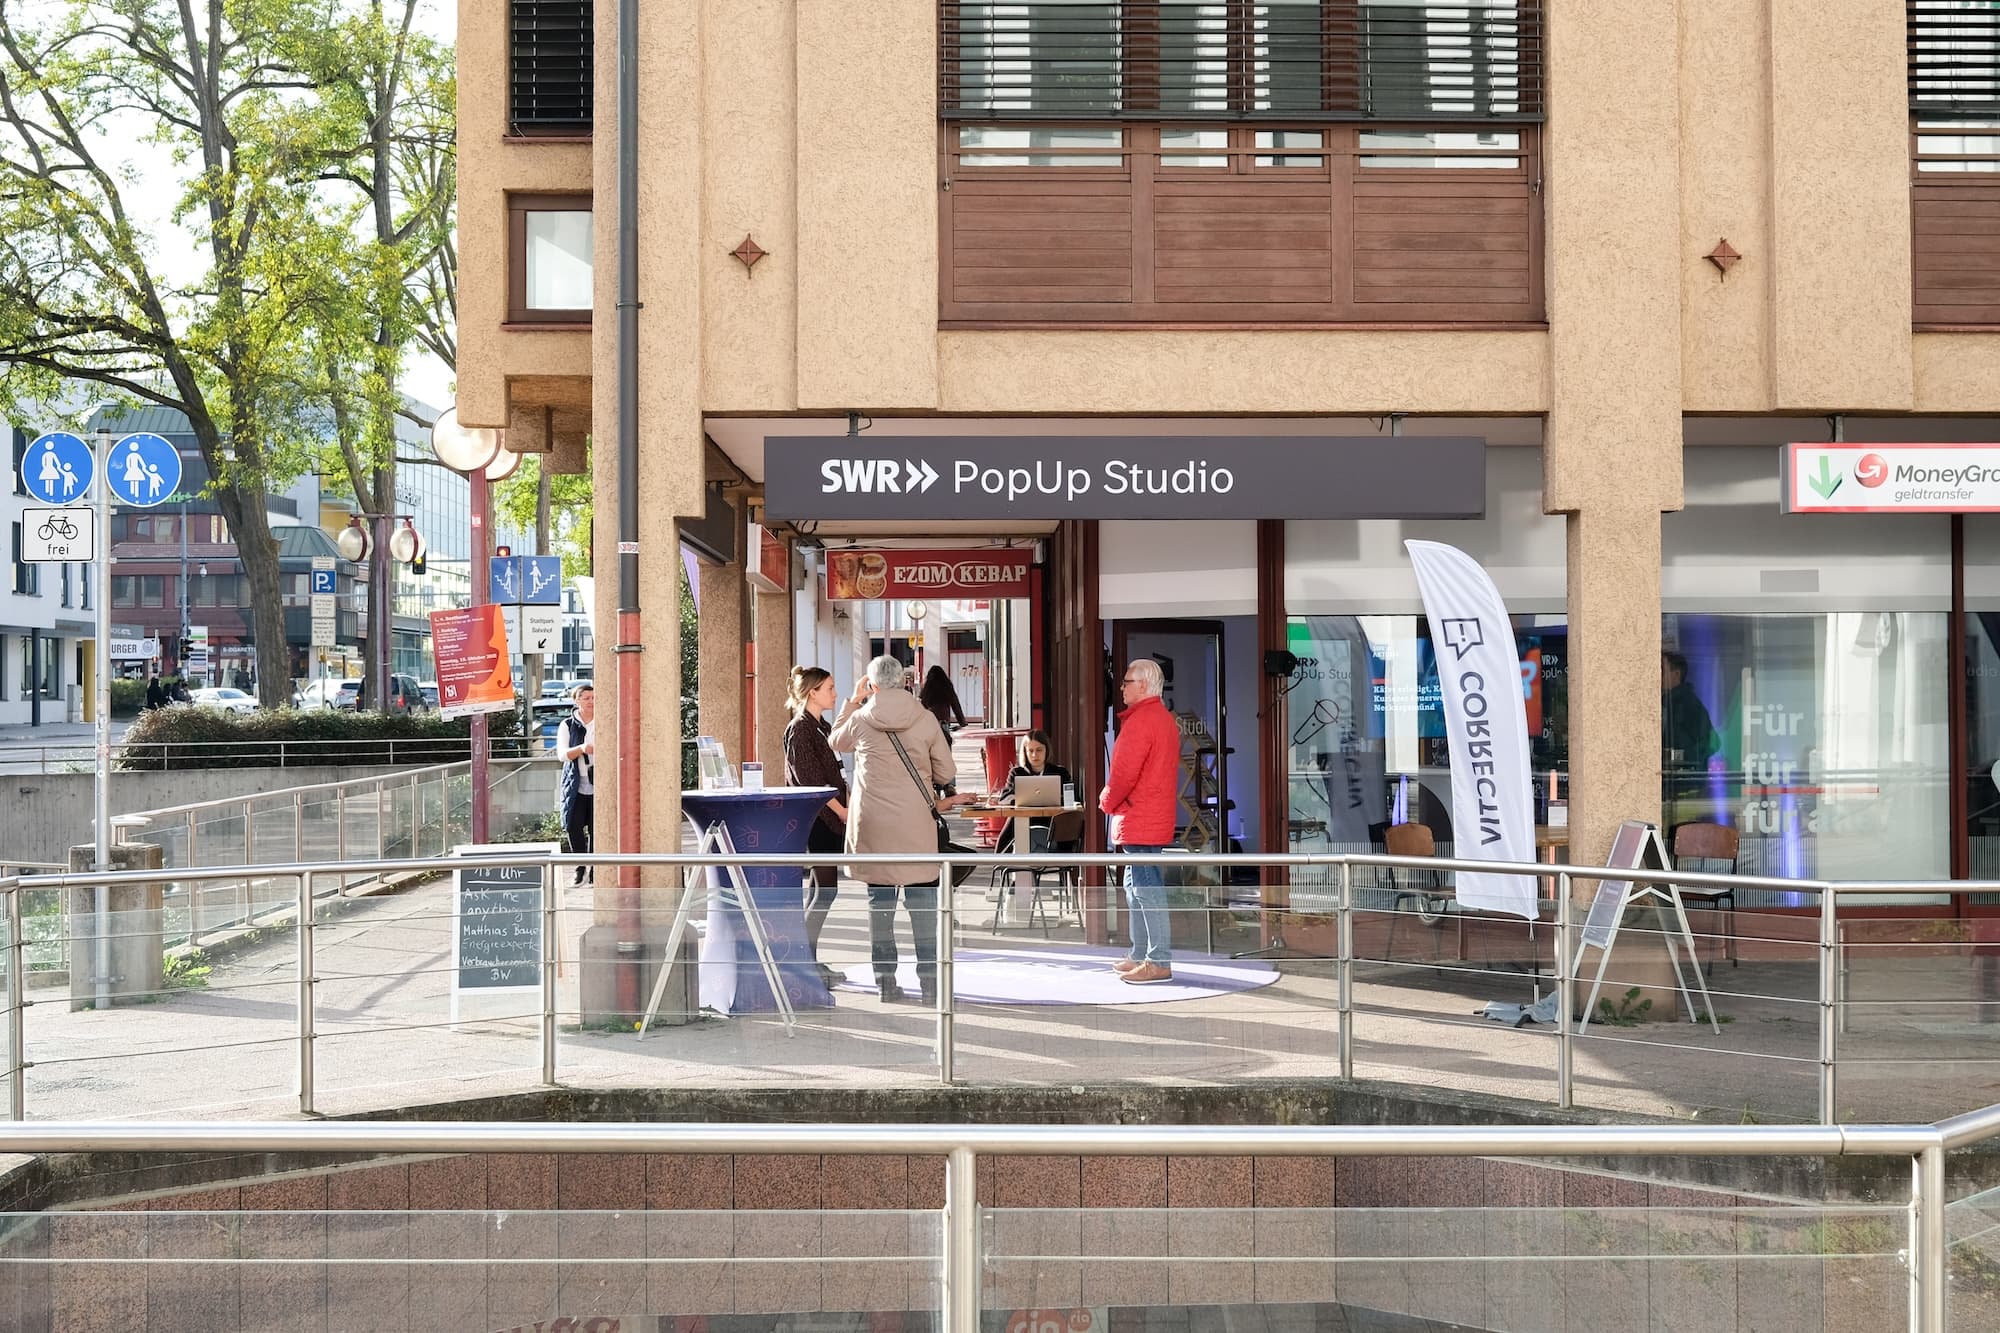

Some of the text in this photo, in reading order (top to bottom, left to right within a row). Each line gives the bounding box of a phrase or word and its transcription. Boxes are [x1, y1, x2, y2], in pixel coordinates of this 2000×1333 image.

[820, 458, 1234, 501] SWR PopUp Studio
[1894, 488, 1974, 502] geldtransfer
[47, 543, 69, 555] frei
[315, 572, 330, 592] P
[893, 564, 1027, 584] EZOM KEBAP
[111, 644, 137, 654] URGER
[1966, 663, 1999, 677] udio
[1743, 703, 1803, 737] Für
[1742, 752, 1797, 785] für
[1741, 800, 1797, 834] für
[500, 867, 527, 879] Uhr
[463, 924, 508, 936] Matthias
